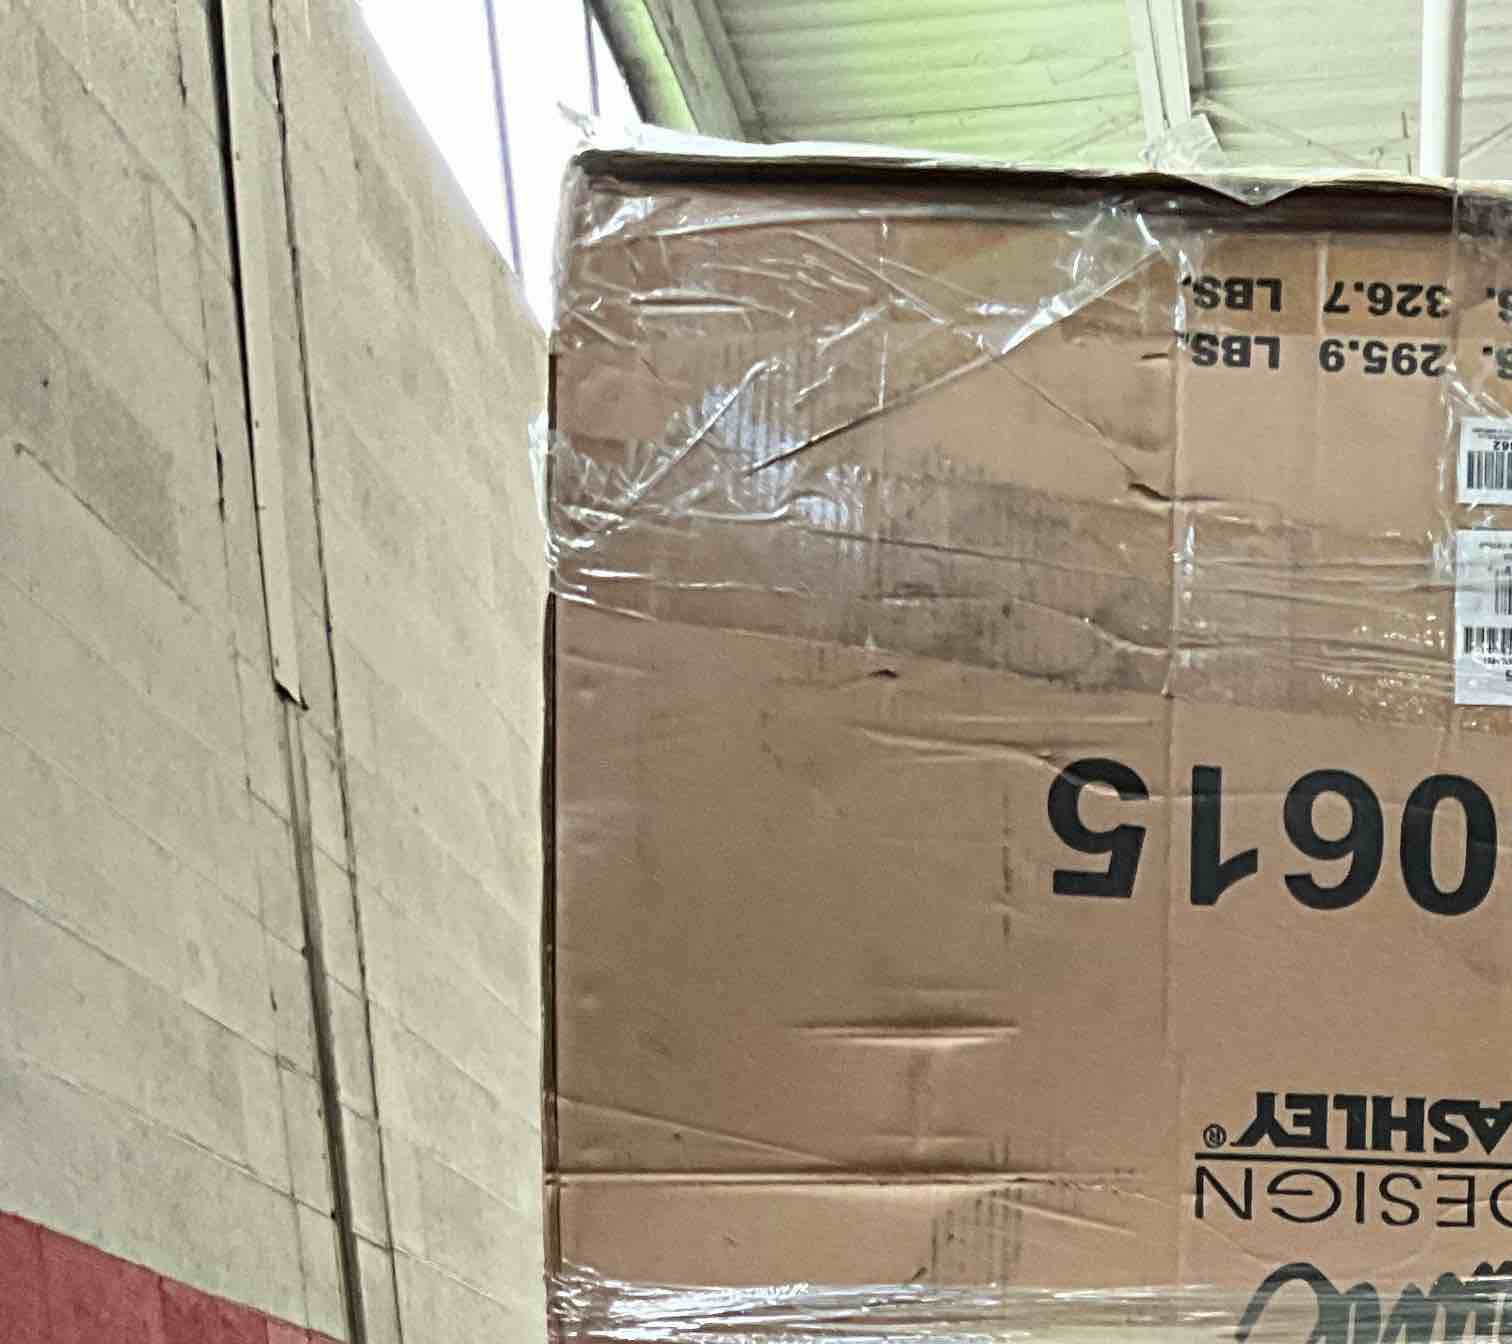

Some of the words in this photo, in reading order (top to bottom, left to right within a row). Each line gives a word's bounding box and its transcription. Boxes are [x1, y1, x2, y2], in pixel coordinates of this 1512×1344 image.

[1180, 275, 1281, 313] LBS.
[1321, 278, 1448, 318] 326.7
[1179, 332, 1279, 370] LBS.
[1318, 338, 1446, 376] 295.9
